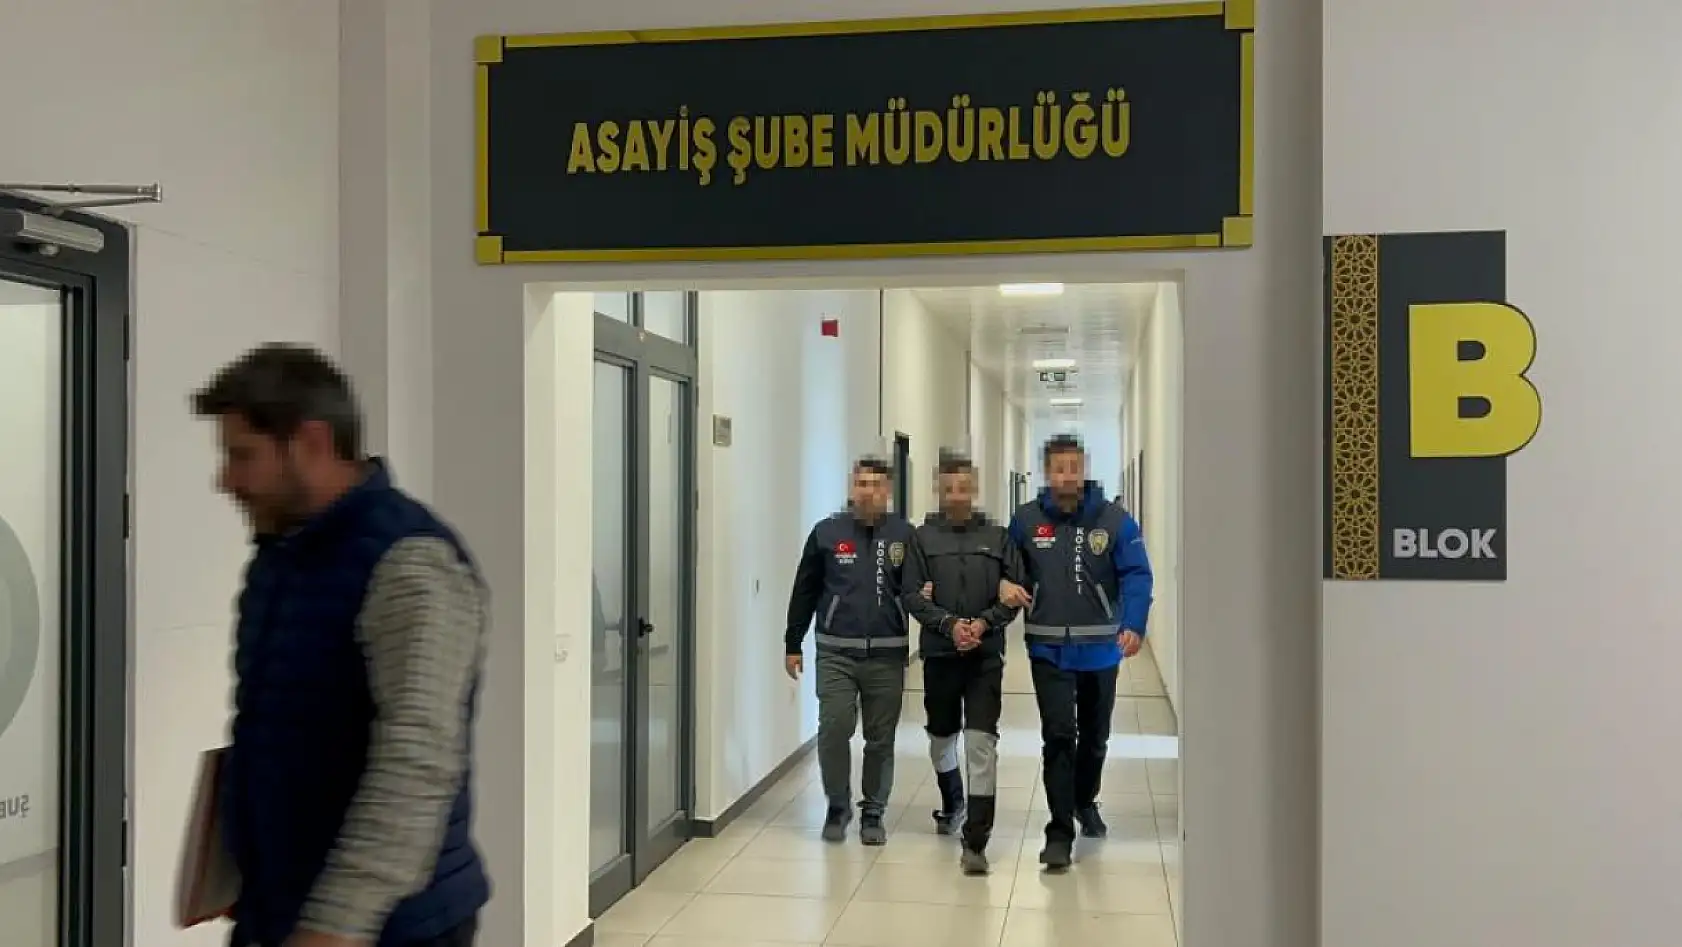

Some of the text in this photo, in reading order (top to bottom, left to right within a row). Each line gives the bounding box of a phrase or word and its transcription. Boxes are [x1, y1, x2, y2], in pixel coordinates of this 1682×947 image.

[567, 87, 1132, 185] ASAYİŞ ŞUBE MÜDÜRLÜĞÜ
[1408, 302, 1542, 458] B
[1392, 528, 1497, 559] BLOK
